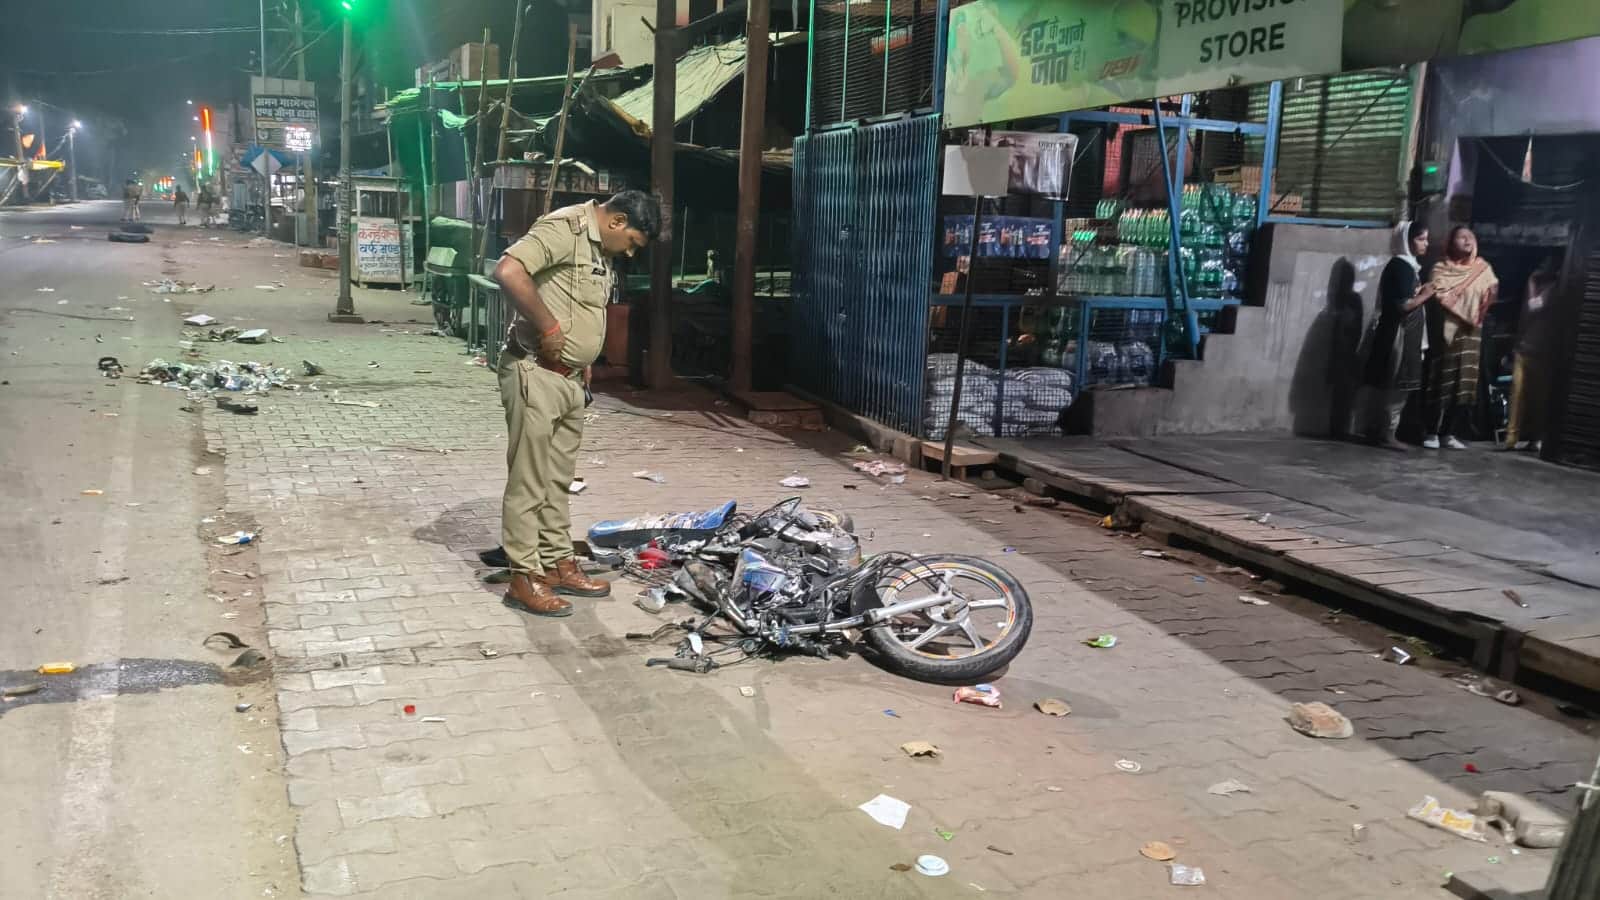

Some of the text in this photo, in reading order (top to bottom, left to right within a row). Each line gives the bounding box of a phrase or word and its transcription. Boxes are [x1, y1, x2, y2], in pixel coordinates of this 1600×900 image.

[1059, 17, 1087, 47] आगे
[1199, 22, 1287, 64] STORE
[1031, 43, 1072, 86] जीत
